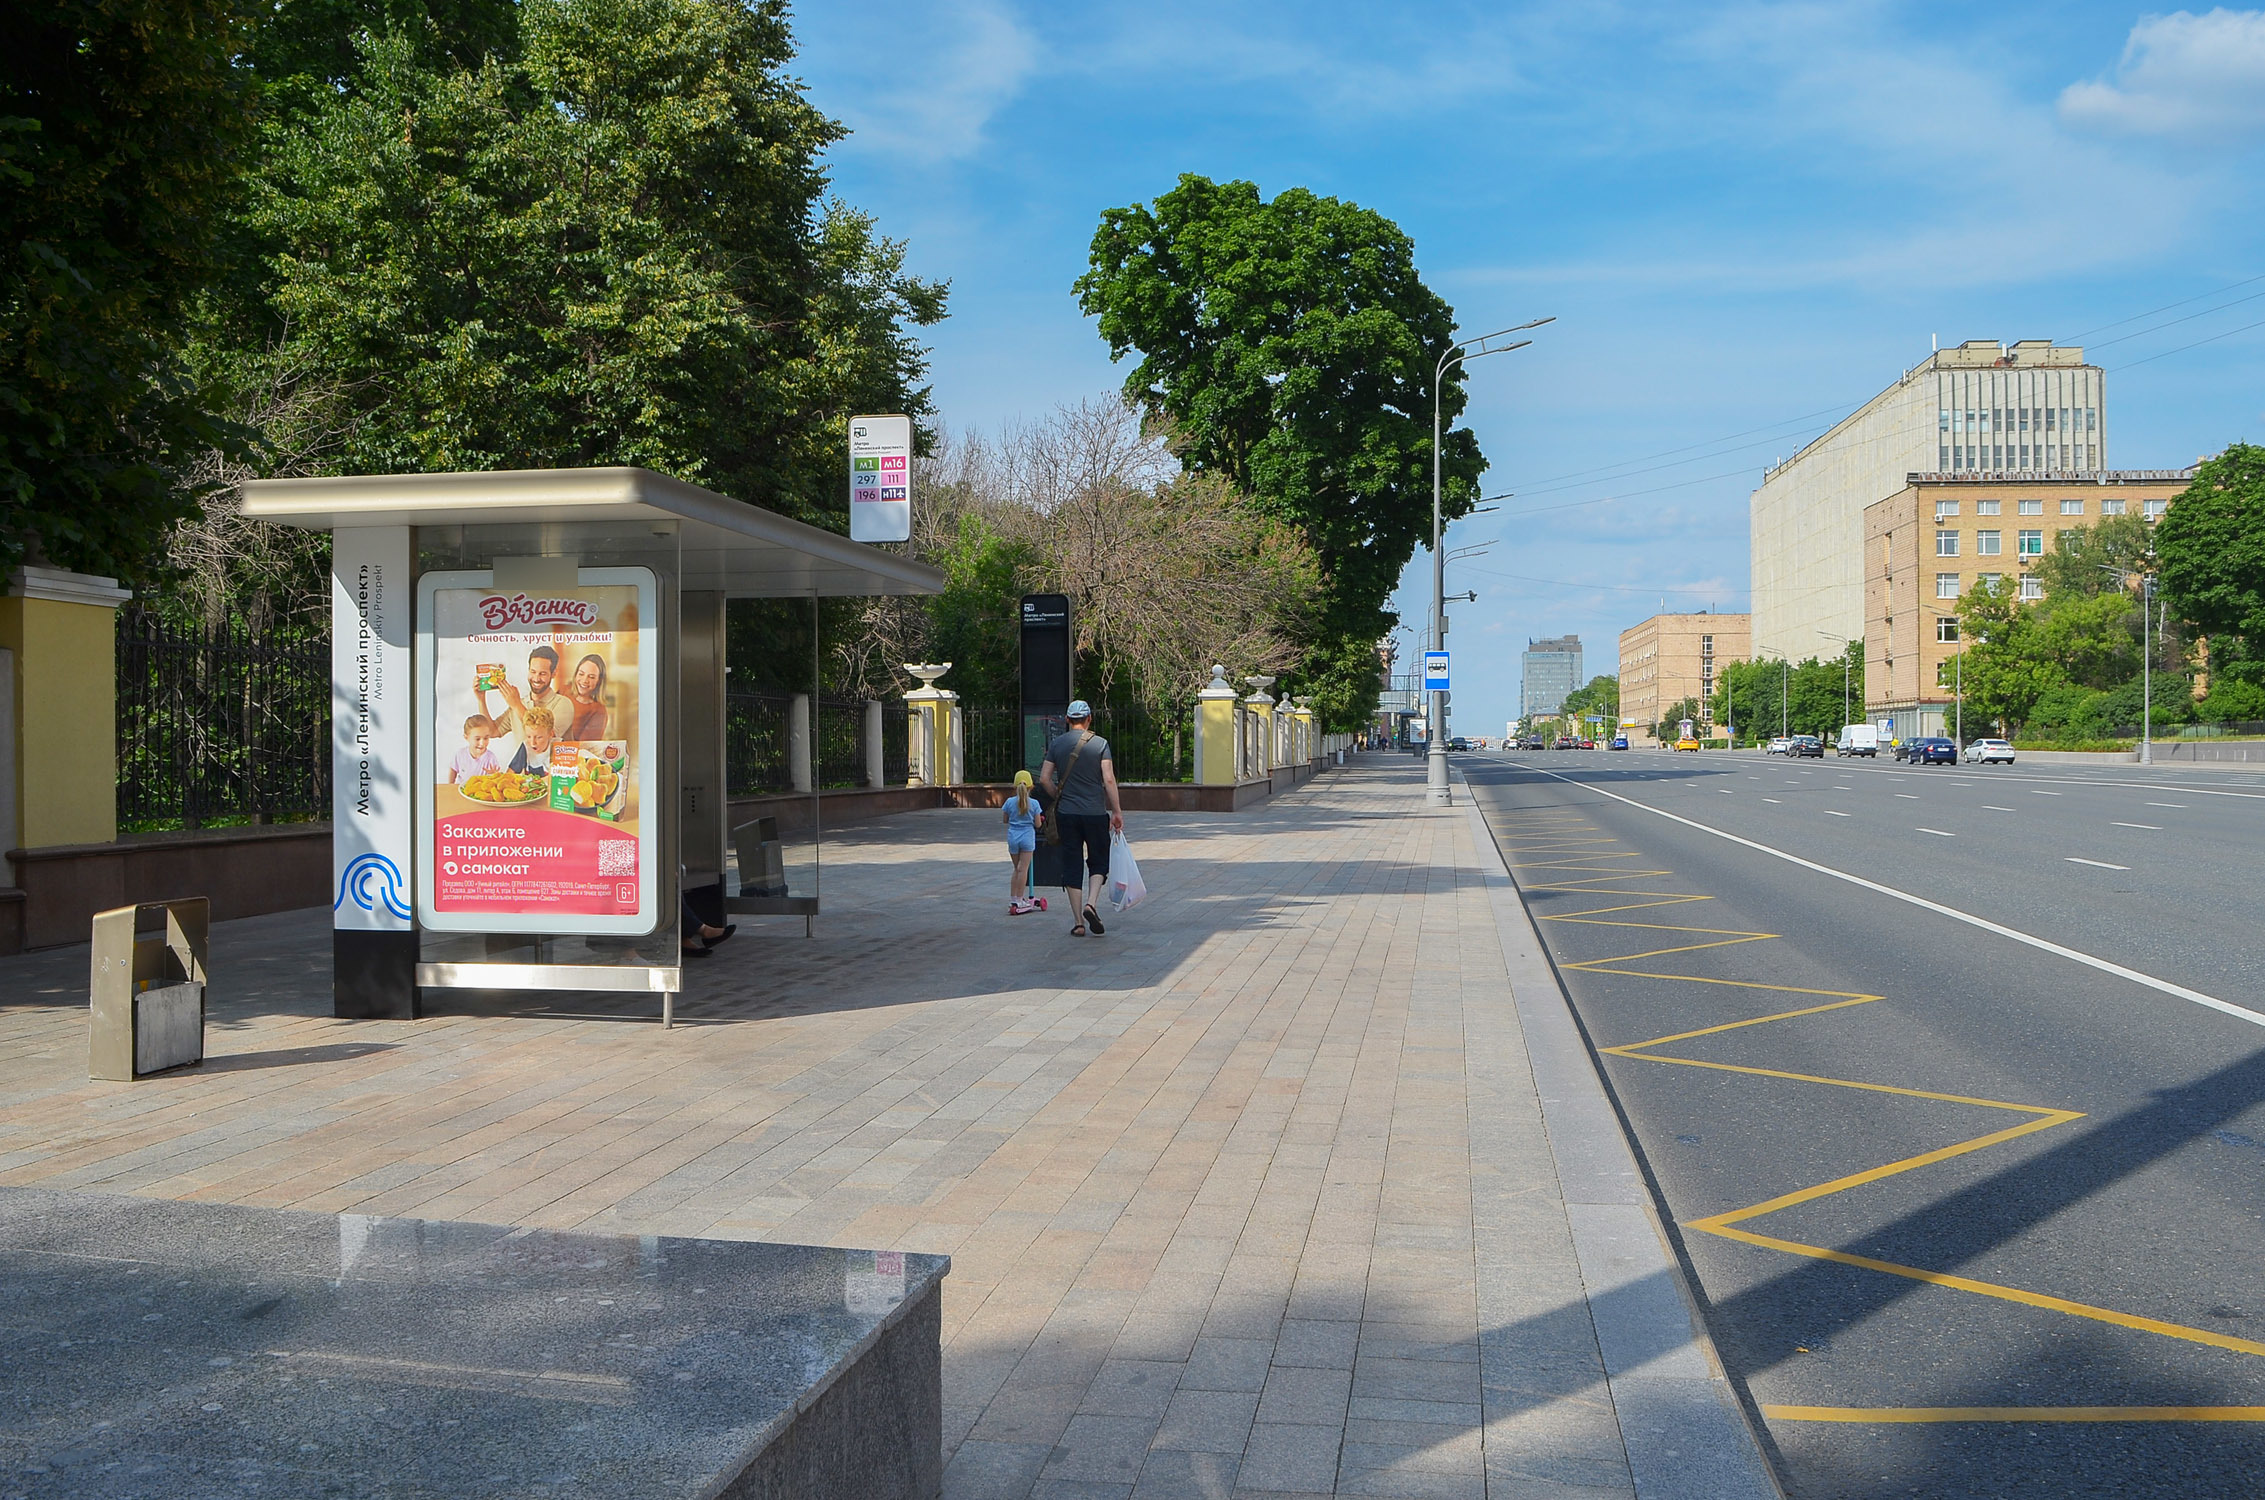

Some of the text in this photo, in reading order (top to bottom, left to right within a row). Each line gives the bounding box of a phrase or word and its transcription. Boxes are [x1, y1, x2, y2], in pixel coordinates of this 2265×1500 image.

[857, 474, 899, 485] 297 111
[858, 490, 876, 500] 196
[373, 564, 384, 700] Metro Leninskiy Prospekt
[522, 634, 553, 645] хруст
[555, 634, 563, 642] и
[565, 632, 612, 644] улыбки!
[356, 564, 371, 816] Метро «Ленинский проспект»
[442, 823, 526, 839] Закажите
[442, 845, 563, 860] в приложении
[461, 863, 530, 875] самокат
[621, 886, 631, 900] 6+
